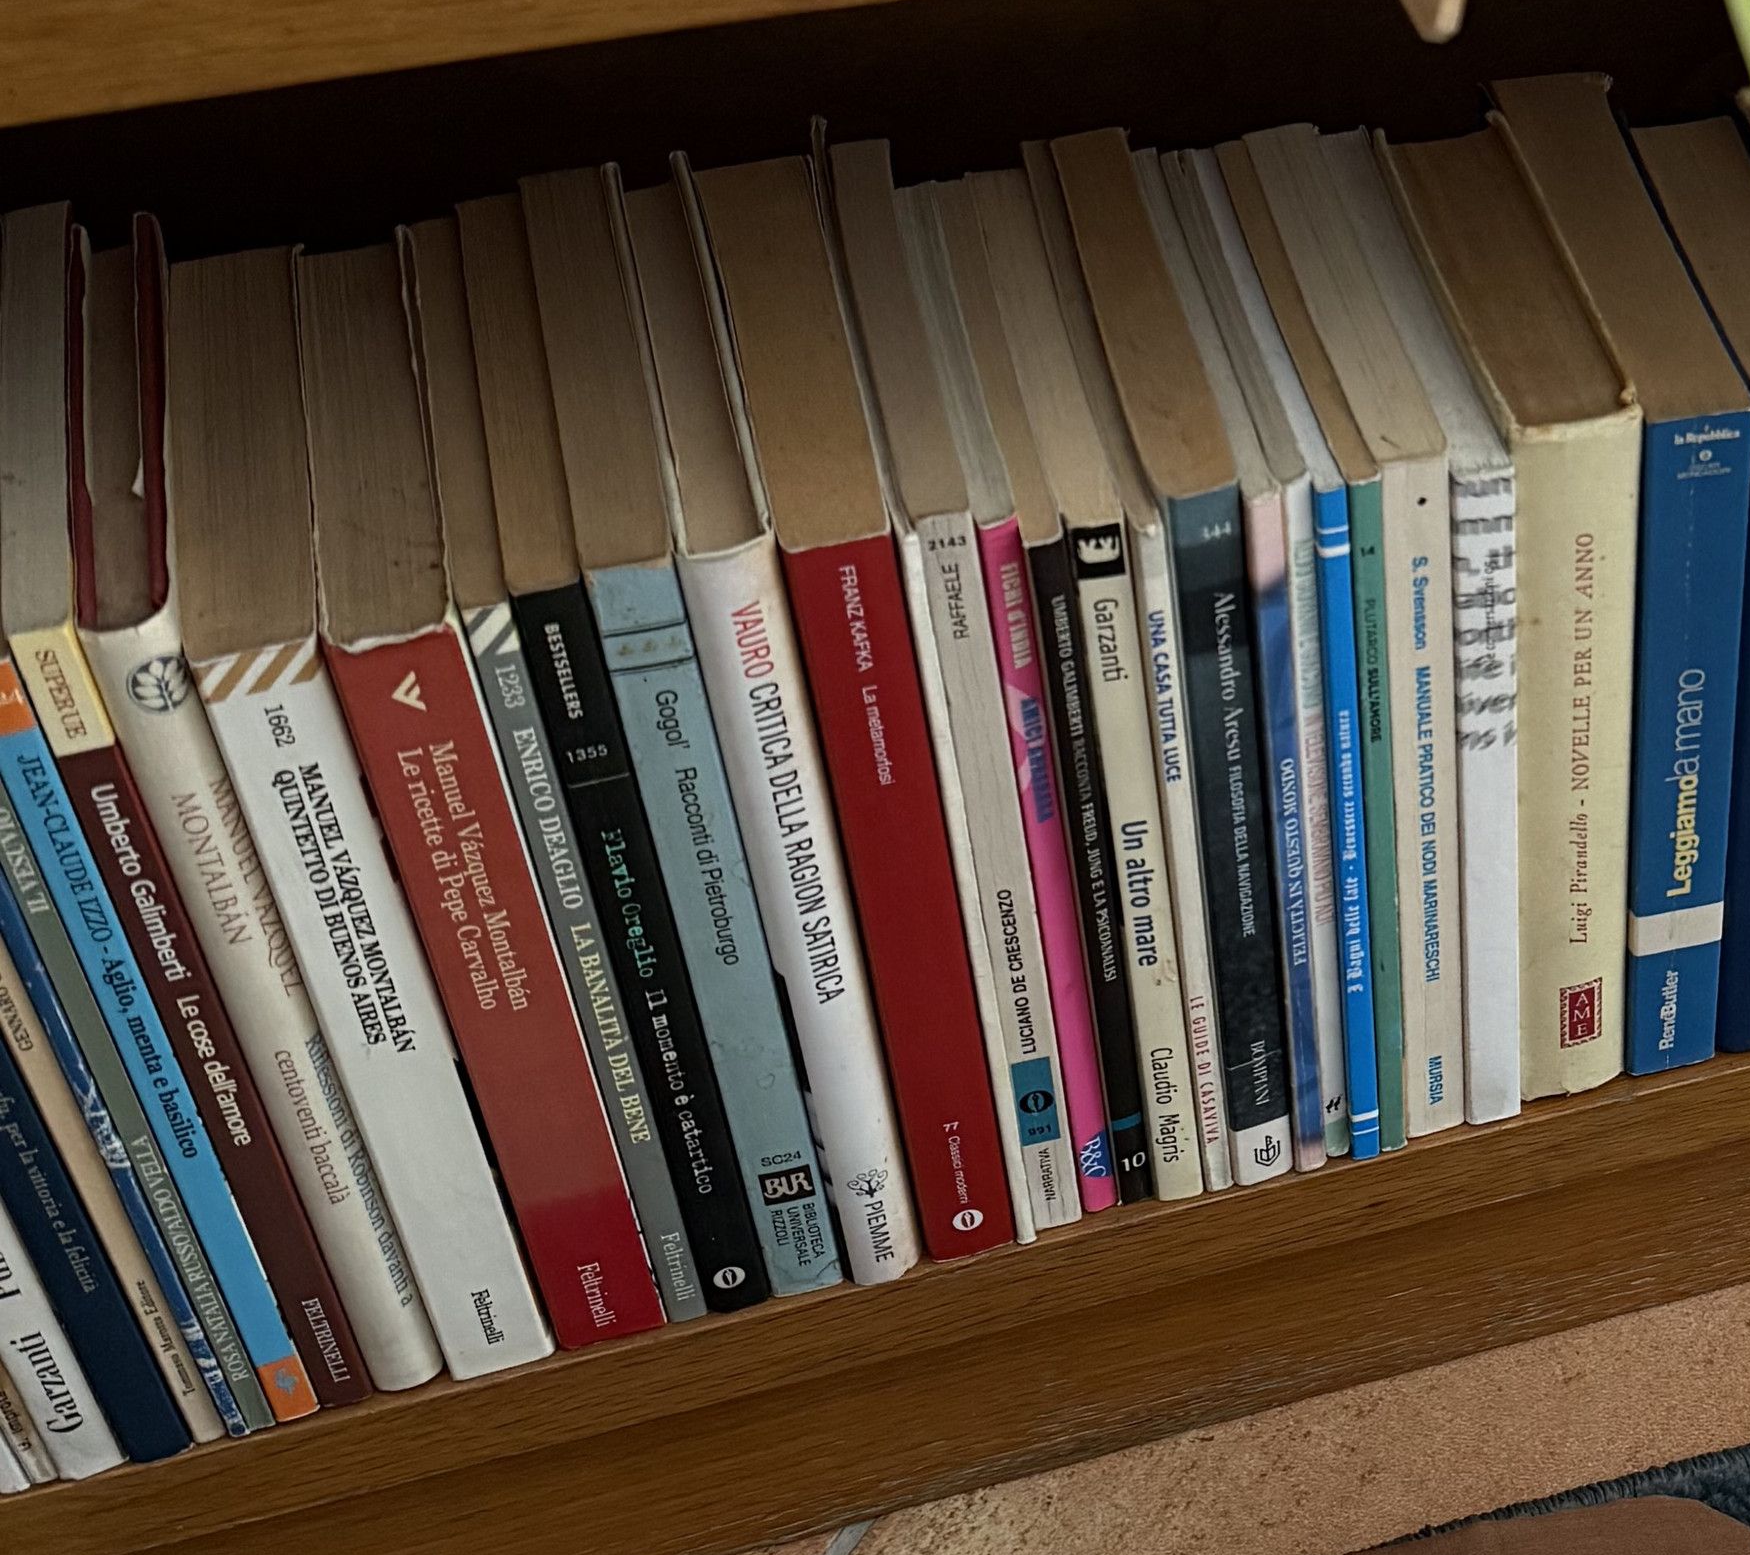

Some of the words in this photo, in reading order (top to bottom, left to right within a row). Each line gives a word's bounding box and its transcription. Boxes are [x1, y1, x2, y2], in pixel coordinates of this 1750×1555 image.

[836, 563, 864, 618] FRANZ
[1411, 556, 1429, 572] S.
[1573, 533, 1593, 598] ANNO
[728, 601, 776, 681] VAURO
[1084, 595, 1136, 683] Garzanti
[1146, 610, 1167, 647] UNA
[1412, 577, 1432, 650] Svensson
[1574, 610, 1591, 640] UN
[544, 621, 583, 720] BESTSELLERS
[846, 619, 876, 672] KAFKA
[1151, 651, 1172, 692] CASA
[1573, 649, 1590, 686] PER
[493, 661, 527, 710] 1233
[860, 684, 880, 705] La
[1415, 666, 1433, 739] MANUALE
[1671, 668, 1705, 751] mano
[262, 702, 296, 749] 1662
[745, 680, 797, 770] CRITICA
[863, 705, 897, 785] metamorfosi
[1157, 696, 1178, 741] TUTTA
[1571, 695, 1590, 790] NOVELLE
[396, 745, 428, 779] Le
[511, 725, 556, 813] ENRICO
[565, 745, 608, 762] 1355
[1163, 745, 1182, 782] LUCE
[1417, 744, 1435, 806] PRATICO
[15, 749, 93, 898] JEAN-CLAUDE
[87, 779, 148, 880] Umberto
[270, 767, 330, 887] QUINTETTO
[406, 777, 448, 847] ricette
[672, 764, 715, 848] Racconti
[767, 769, 812, 836] DELLA
[1420, 812, 1436, 836] DEI
[430, 846, 458, 872] di
[537, 813, 585, 912] DEAGLIO
[695, 845, 720, 868] di
[1120, 820, 1149, 850] Un
[1421, 840, 1438, 875] NODI
[1568, 813, 1589, 893] Pirandello
[167, 786, 255, 947] MONTALBÁN
[428, 738, 474, 821] Manuel
[451, 821, 502, 909] Vázquez
[481, 907, 534, 1012] Montalbán
[782, 837, 829, 913] RAGION
[1124, 856, 1158, 909] altro
[76, 895, 113, 943] IZZO
[297, 759, 346, 850] MANUEL
[324, 847, 379, 942] VÁZQUEZ
[358, 936, 418, 1056] MONTALBÁN
[314, 884, 339, 912] DI
[433, 871, 475, 925] Pepe
[693, 865, 746, 968] Pietroburgo
[1569, 902, 1591, 943] Luigi
[127, 875, 191, 984] Galimberti
[323, 910, 366, 990] BUENOS
[569, 921, 597, 951] LA
[799, 916, 850, 1005] SATIRICA
[994, 888, 1023, 972] CRESCENZO
[1133, 914, 1160, 967] mare
[1422, 880, 1441, 981] MARINARESCHI
[97, 951, 142, 1015] Aglio,
[454, 921, 504, 1012] Carvalho
[1008, 974, 1027, 993] DE
[175, 991, 203, 1020] Le
[349, 987, 386, 1047] AIRES
[578, 949, 631, 1052] BANALITÀ
[1012, 996, 1037, 1055] LUCIANO
[125, 1012, 166, 1076] menta
[185, 1018, 215, 1061] cose
[151, 1074, 168, 1088] e
[202, 1056, 257, 1147] dell'amore
[607, 1051, 637, 1093] DEL
[1149, 1046, 1178, 1104] Claudio
[1425, 1055, 1444, 1104] MURSIA
[157, 1087, 203, 1160] basilico
[270, 1046, 325, 1142] centoventi
[308, 1139, 352, 1206] baccalà
[619, 1092, 651, 1144] BENE
[1151, 1113, 1186, 1163] Magris
[761, 1151, 801, 1167] SC24
[764, 1172, 813, 1198] BUR
[863, 1199, 895, 1262] PIEMME
[575, 1259, 615, 1328] Feltrinelli
[659, 1231, 696, 1302] Feltrinelli
[300, 1294, 350, 1383] FELTRINELLI
[470, 1288, 504, 1346] Feltrinelli
[9, 1325, 86, 1441] Garzanti
